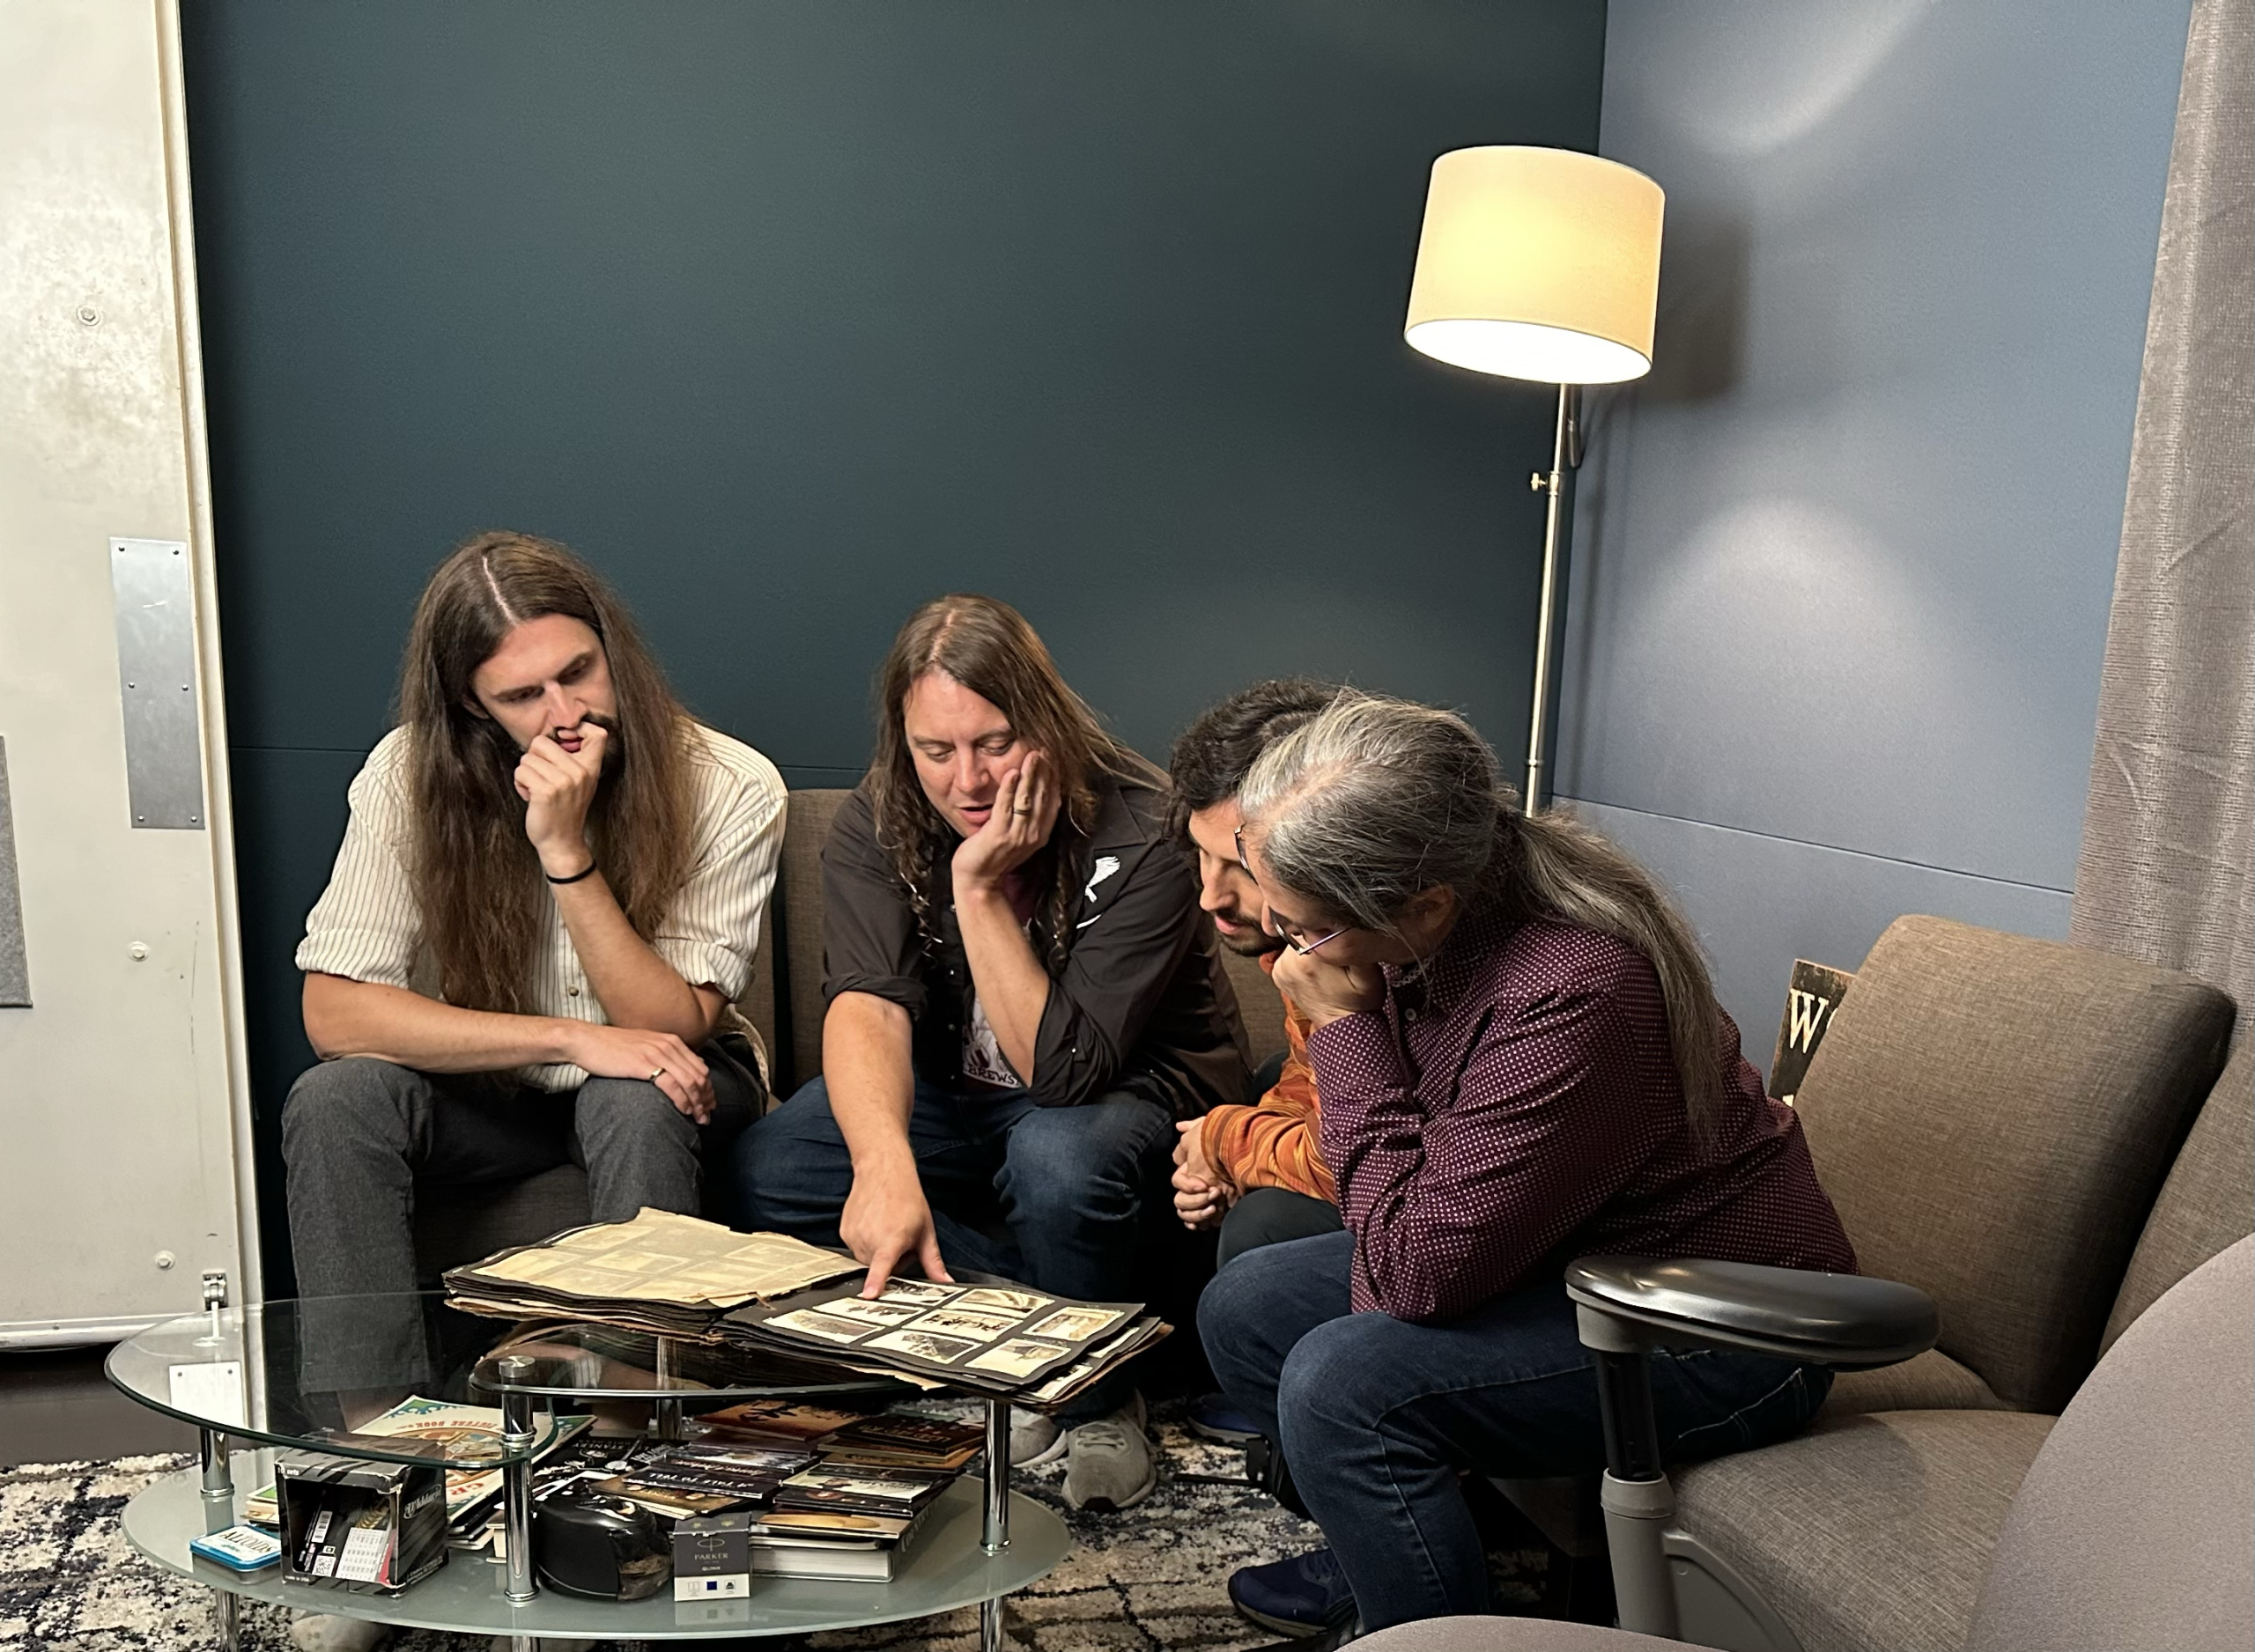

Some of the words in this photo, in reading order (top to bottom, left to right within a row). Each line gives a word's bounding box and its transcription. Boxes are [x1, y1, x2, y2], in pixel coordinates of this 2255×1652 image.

[1789, 987, 1837, 1054] W
[447, 1483, 484, 1495] GR
[218, 1530, 278, 1553] ALTOIDS
